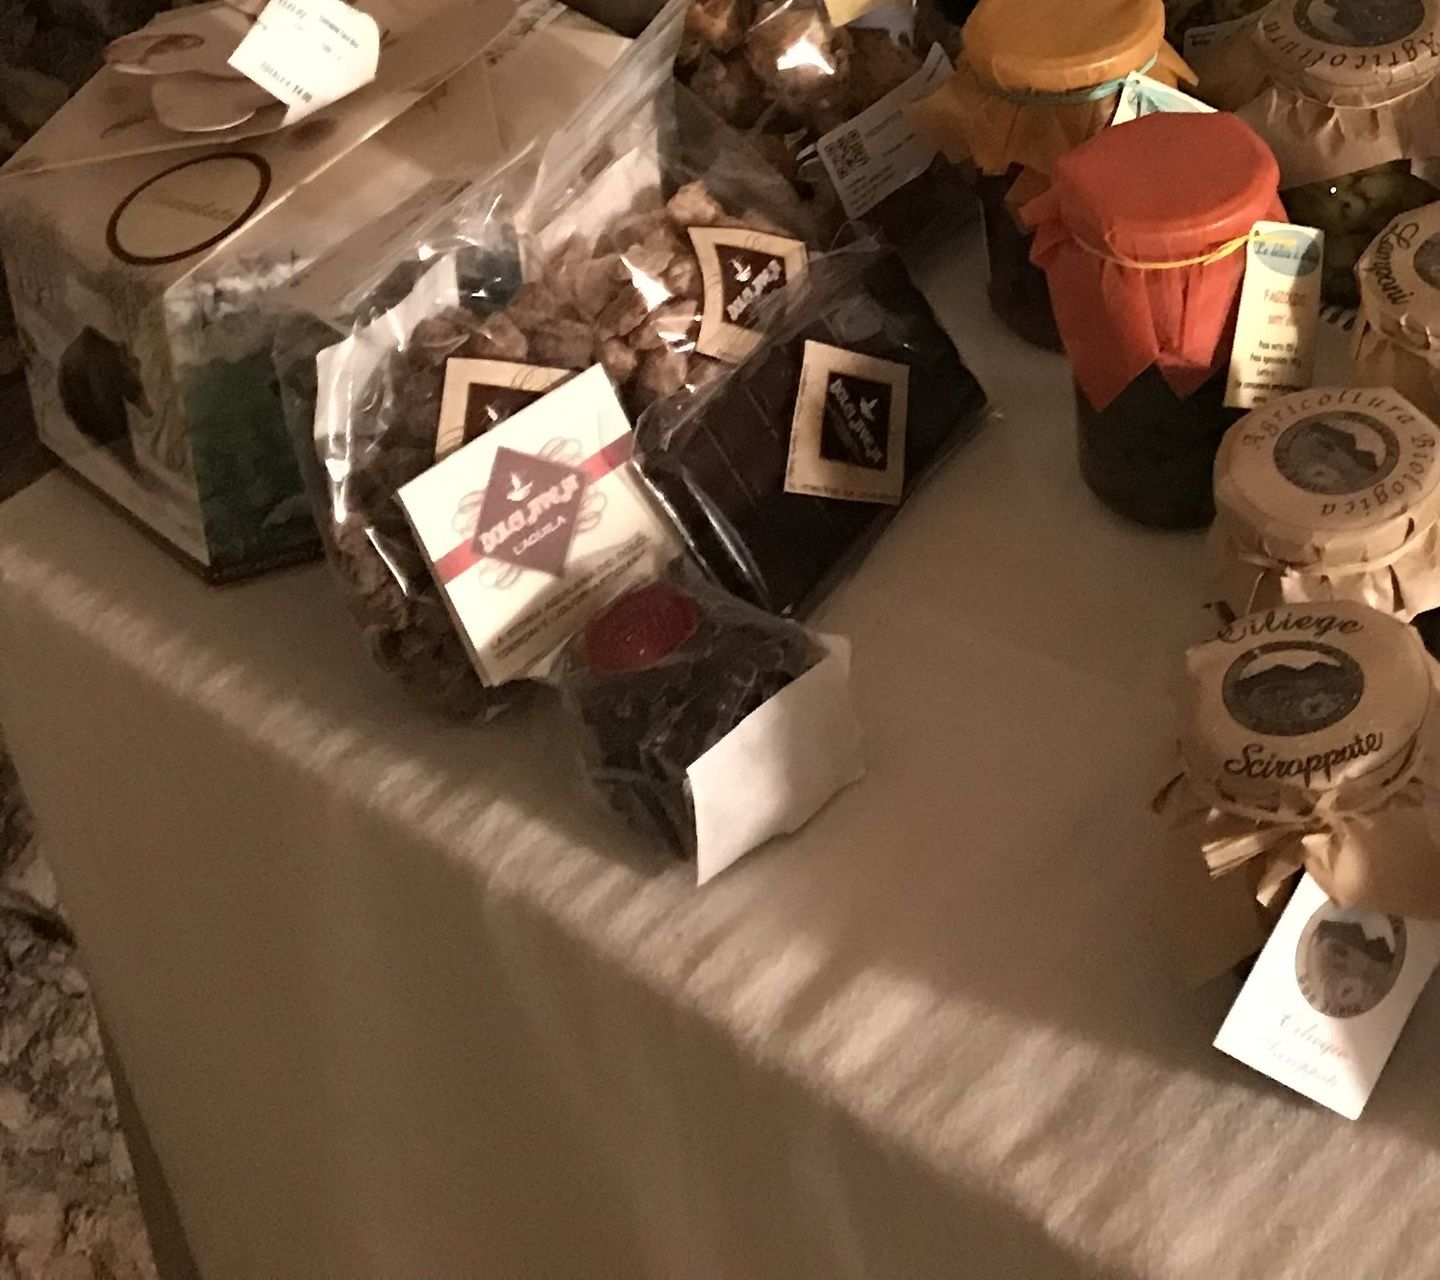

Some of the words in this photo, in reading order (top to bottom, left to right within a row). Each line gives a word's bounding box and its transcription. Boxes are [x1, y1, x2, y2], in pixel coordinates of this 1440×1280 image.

[1242, 389, 1416, 451] Agricoltura
[1319, 432, 1436, 518] Biologica
[1223, 731, 1384, 789] Sciroppate
